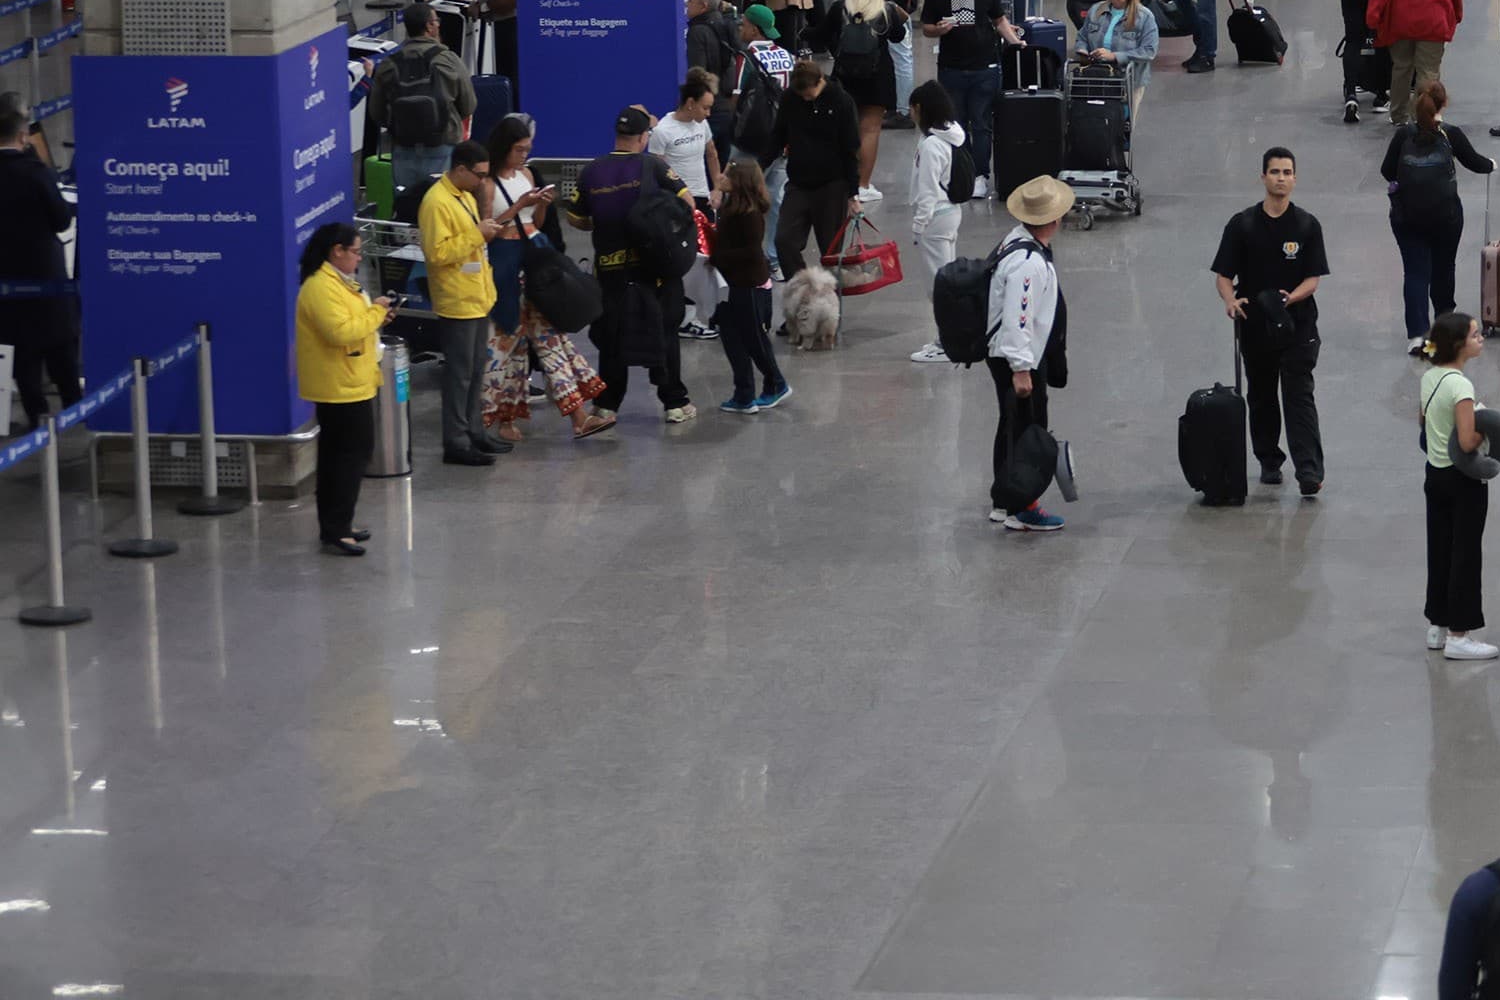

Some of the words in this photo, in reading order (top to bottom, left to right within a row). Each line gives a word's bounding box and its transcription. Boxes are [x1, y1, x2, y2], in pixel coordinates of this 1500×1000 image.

[539, 18, 573, 27] Etiquete
[574, 19, 589, 27] sua
[590, 18, 628, 28] Bagagem
[759, 50, 788, 61] AME
[771, 60, 791, 70] RIO
[147, 117, 206, 128] LATAM
[104, 158, 178, 181] Começa
[182, 158, 230, 181] aqui!
[105, 183, 134, 195] Start
[135, 183, 163, 195] here!
